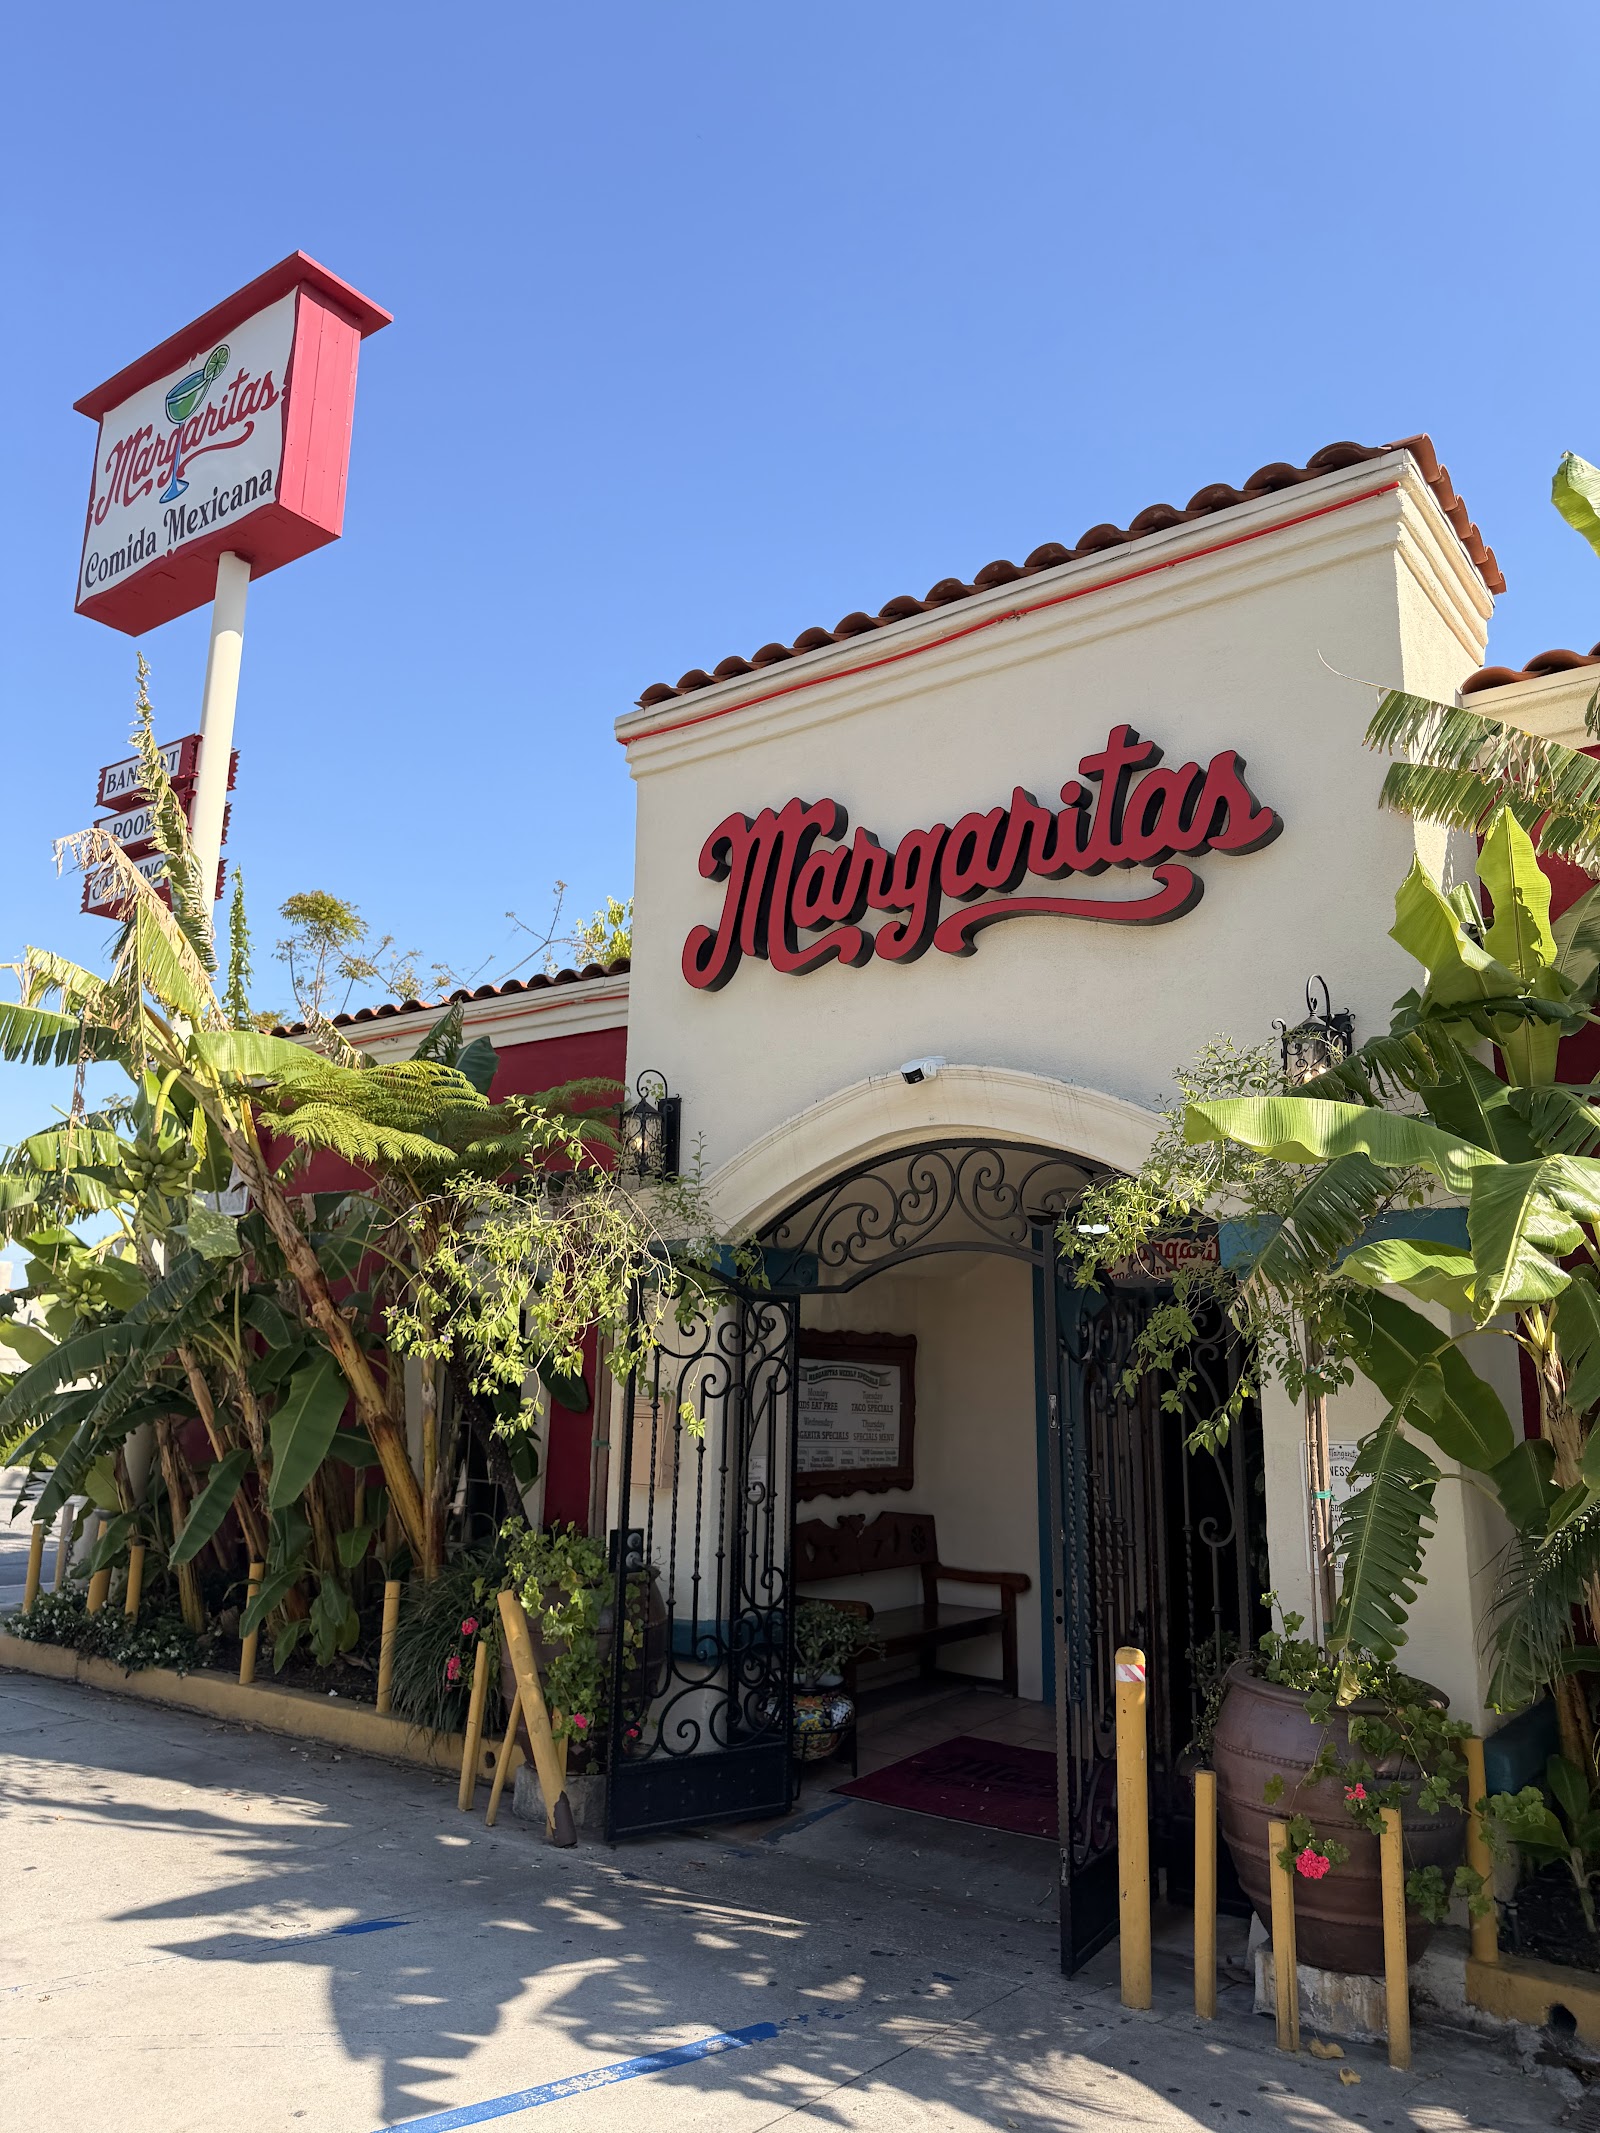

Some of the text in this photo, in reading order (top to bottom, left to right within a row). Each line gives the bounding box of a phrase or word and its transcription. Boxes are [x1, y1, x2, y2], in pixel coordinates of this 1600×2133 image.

[94, 367, 279, 526] Margaritas
[85, 469, 273, 588] Comida Mexicana
[106, 750, 180, 794] BANET
[682, 724, 1284, 992] Margaritas
[807, 1387, 829, 1399] Monday
[862, 1390, 883, 1402] Tuesday
[811, 1402, 822, 1410] EAT
[823, 1402, 838, 1411] FREE
[851, 1403, 894, 1413] TACO SPECIALS
[861, 1419, 885, 1430] Thursday
[821, 1431, 849, 1441] SPECIALS
[853, 1432, 895, 1442] SPECIALS MENU
